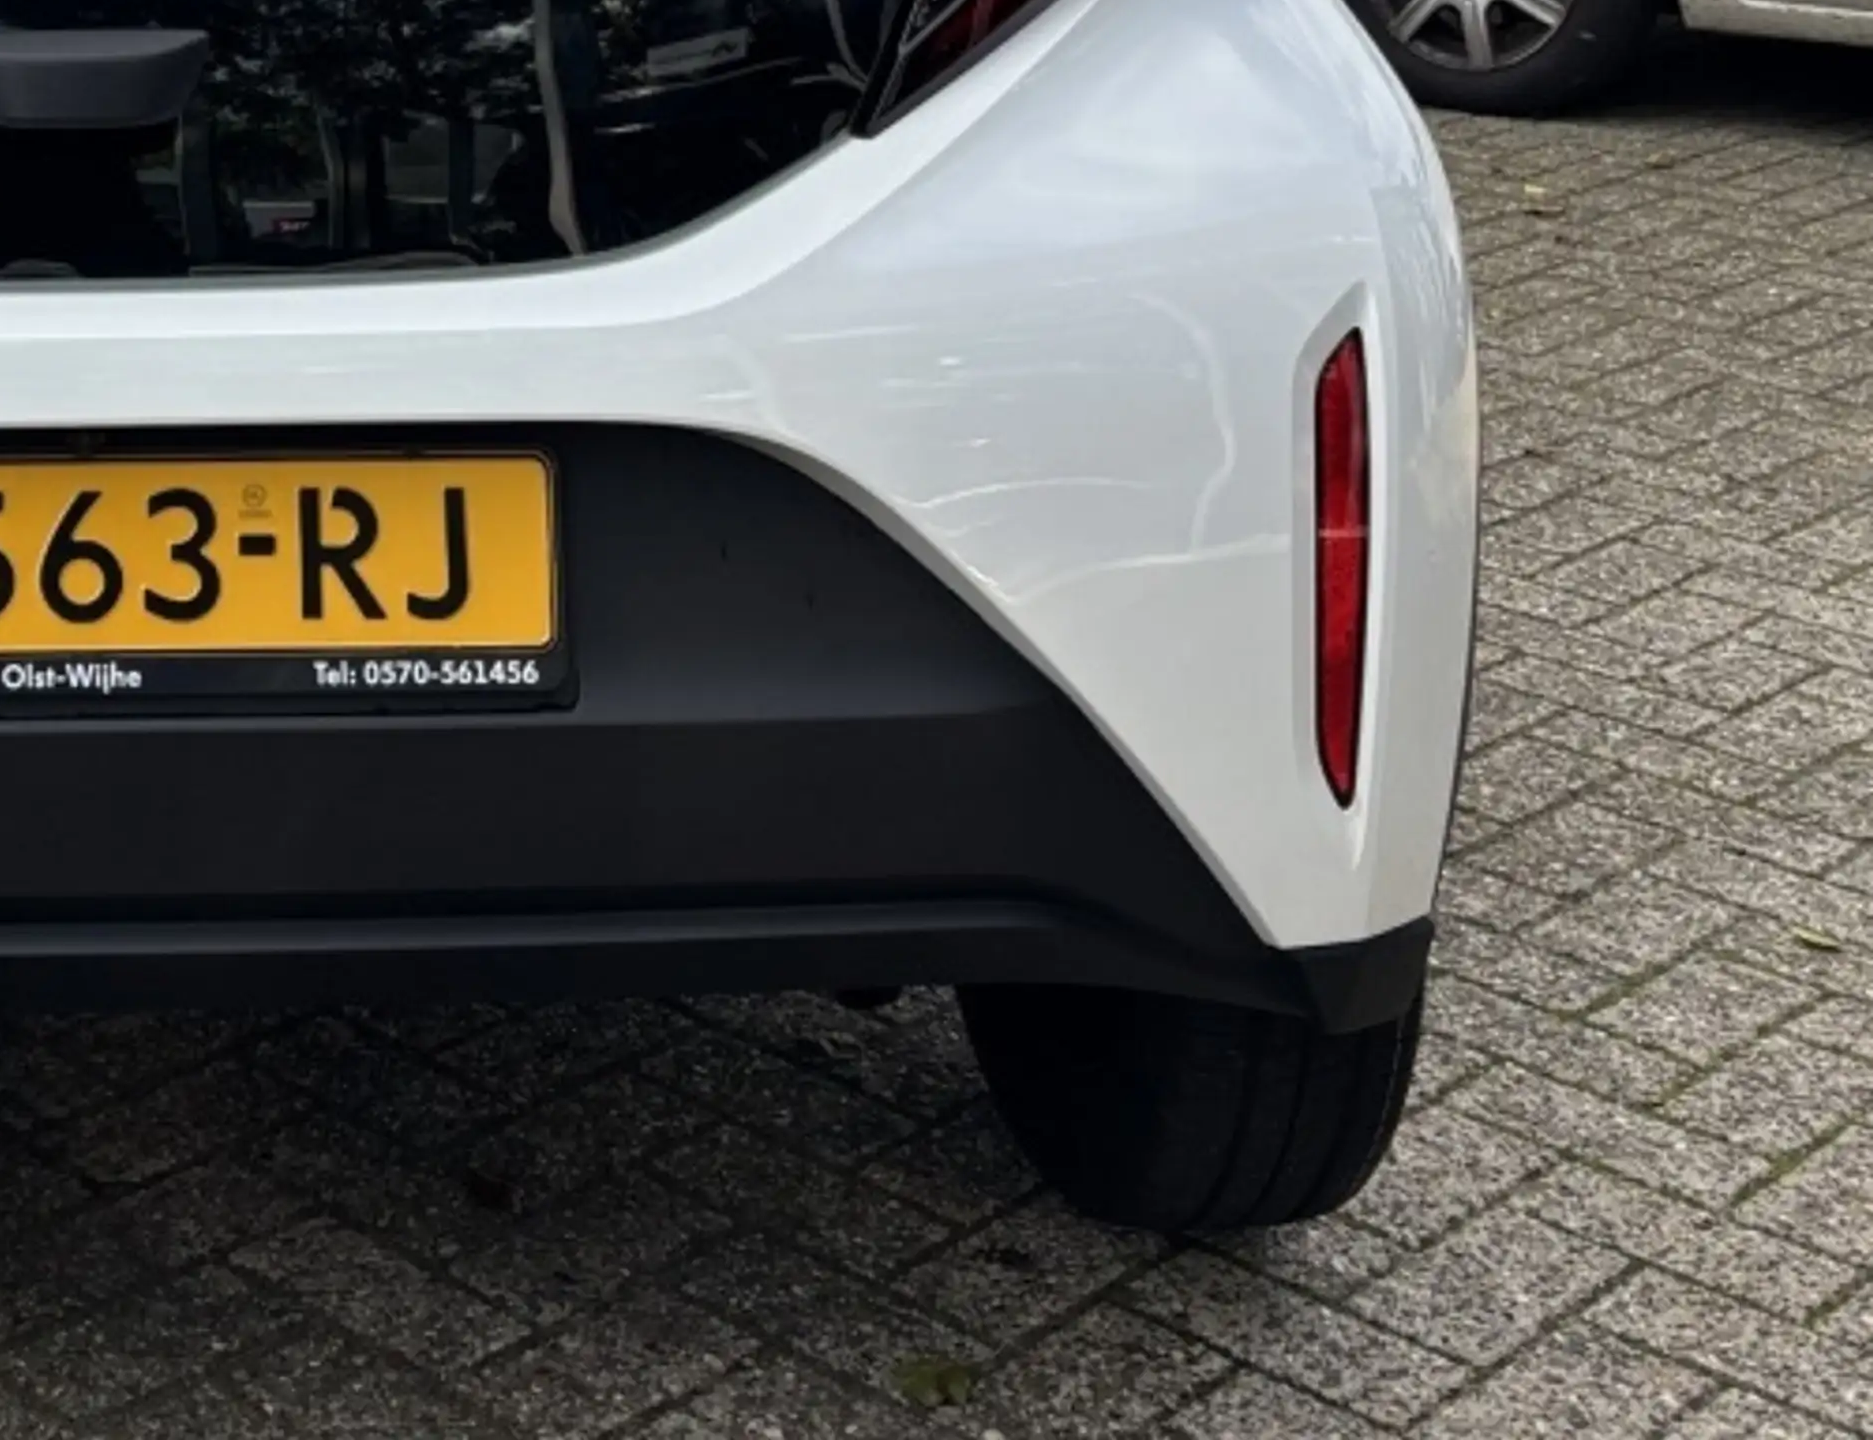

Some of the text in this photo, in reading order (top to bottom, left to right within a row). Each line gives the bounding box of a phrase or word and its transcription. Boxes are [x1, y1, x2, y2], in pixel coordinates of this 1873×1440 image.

[1, 662, 143, 694] Olst-Wijhe
[313, 660, 540, 686] Tel: 0570-561456
